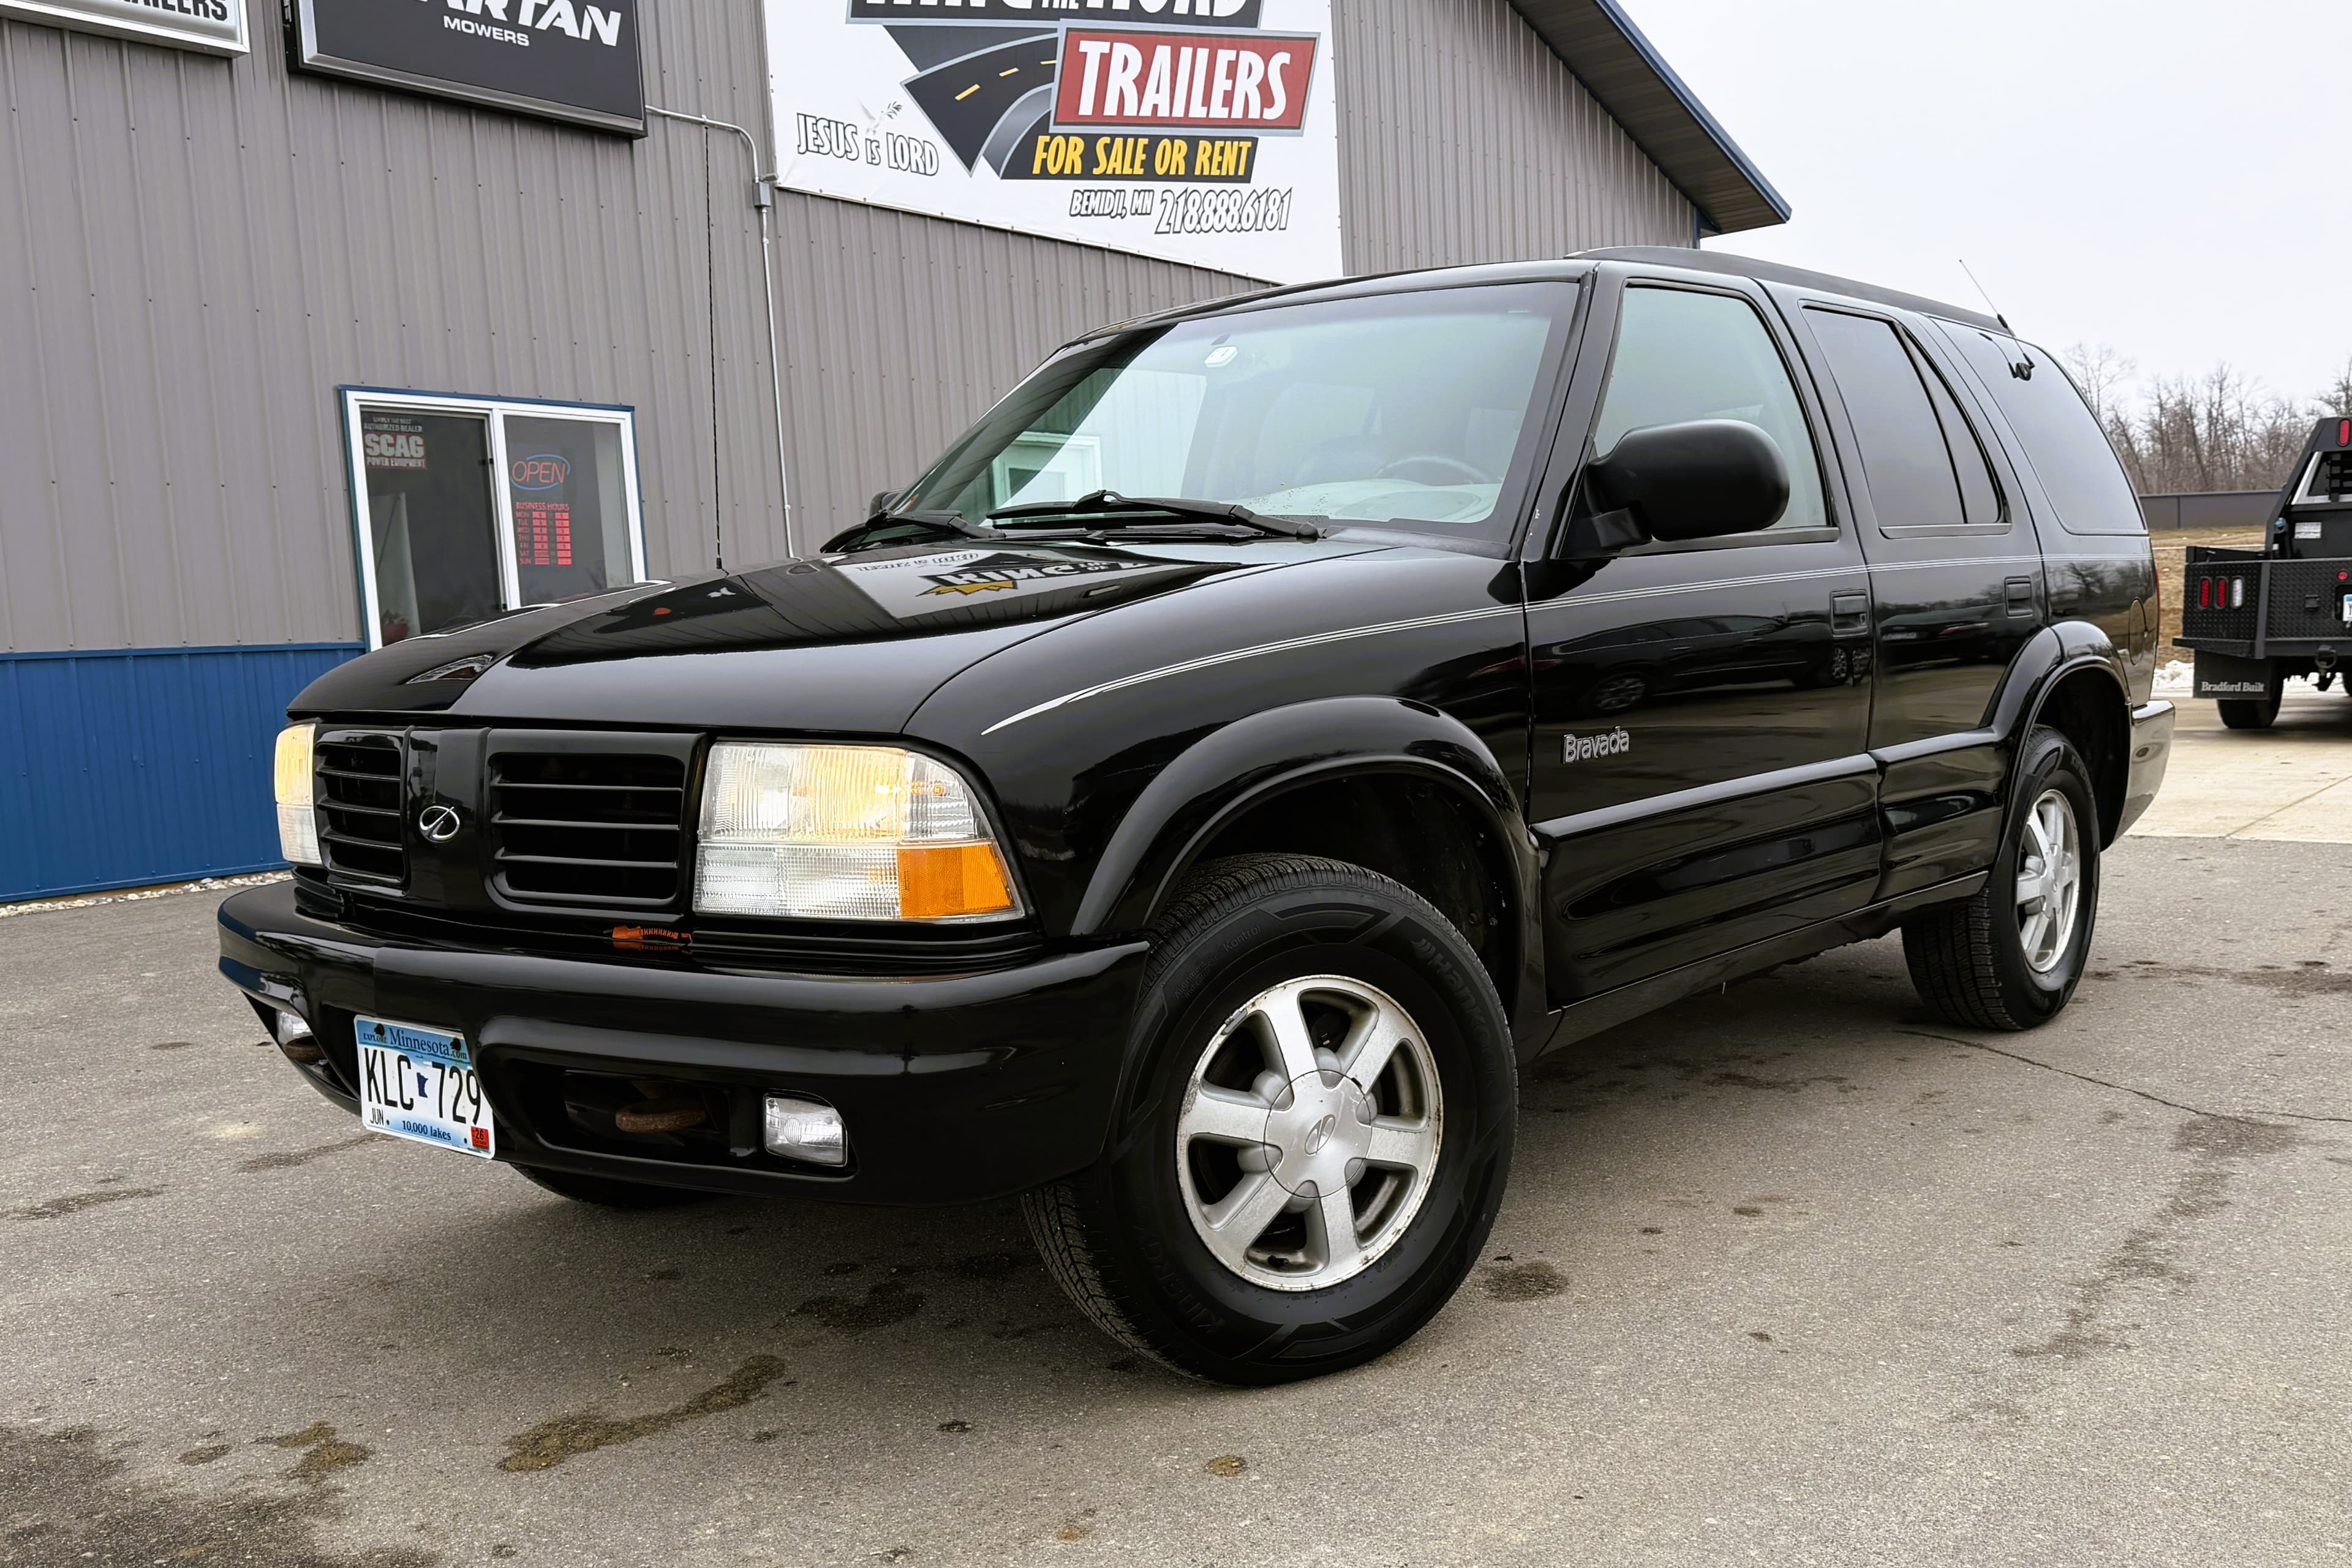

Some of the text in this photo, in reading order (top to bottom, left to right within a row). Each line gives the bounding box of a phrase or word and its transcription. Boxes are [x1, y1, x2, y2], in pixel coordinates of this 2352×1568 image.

[443, 15, 529, 47] MOWERS
[1078, 40, 1291, 120] TRAILERS
[797, 113, 939, 176] JESUS IS LORD
[1032, 135, 1252, 176] FOR SALE OR RENT
[1130, 189, 1155, 216] MN
[1154, 186, 1292, 235] 218.888.6181
[363, 423, 399, 431] AUTHORIZED
[364, 433, 424, 458] SCAG
[367, 457, 391, 467] POWER
[512, 461, 566, 484] OPEN
[516, 502, 546, 510] BUSINESS
[2201, 681, 2264, 692] Bradford Built
[1564, 726, 1629, 764] Bravada
[364, 1047, 481, 1126] KLC 729
[370, 1107, 385, 1126] JUN
[402, 1120, 451, 1141] 10,000 lakes
[475, 1128, 484, 1140] 26
